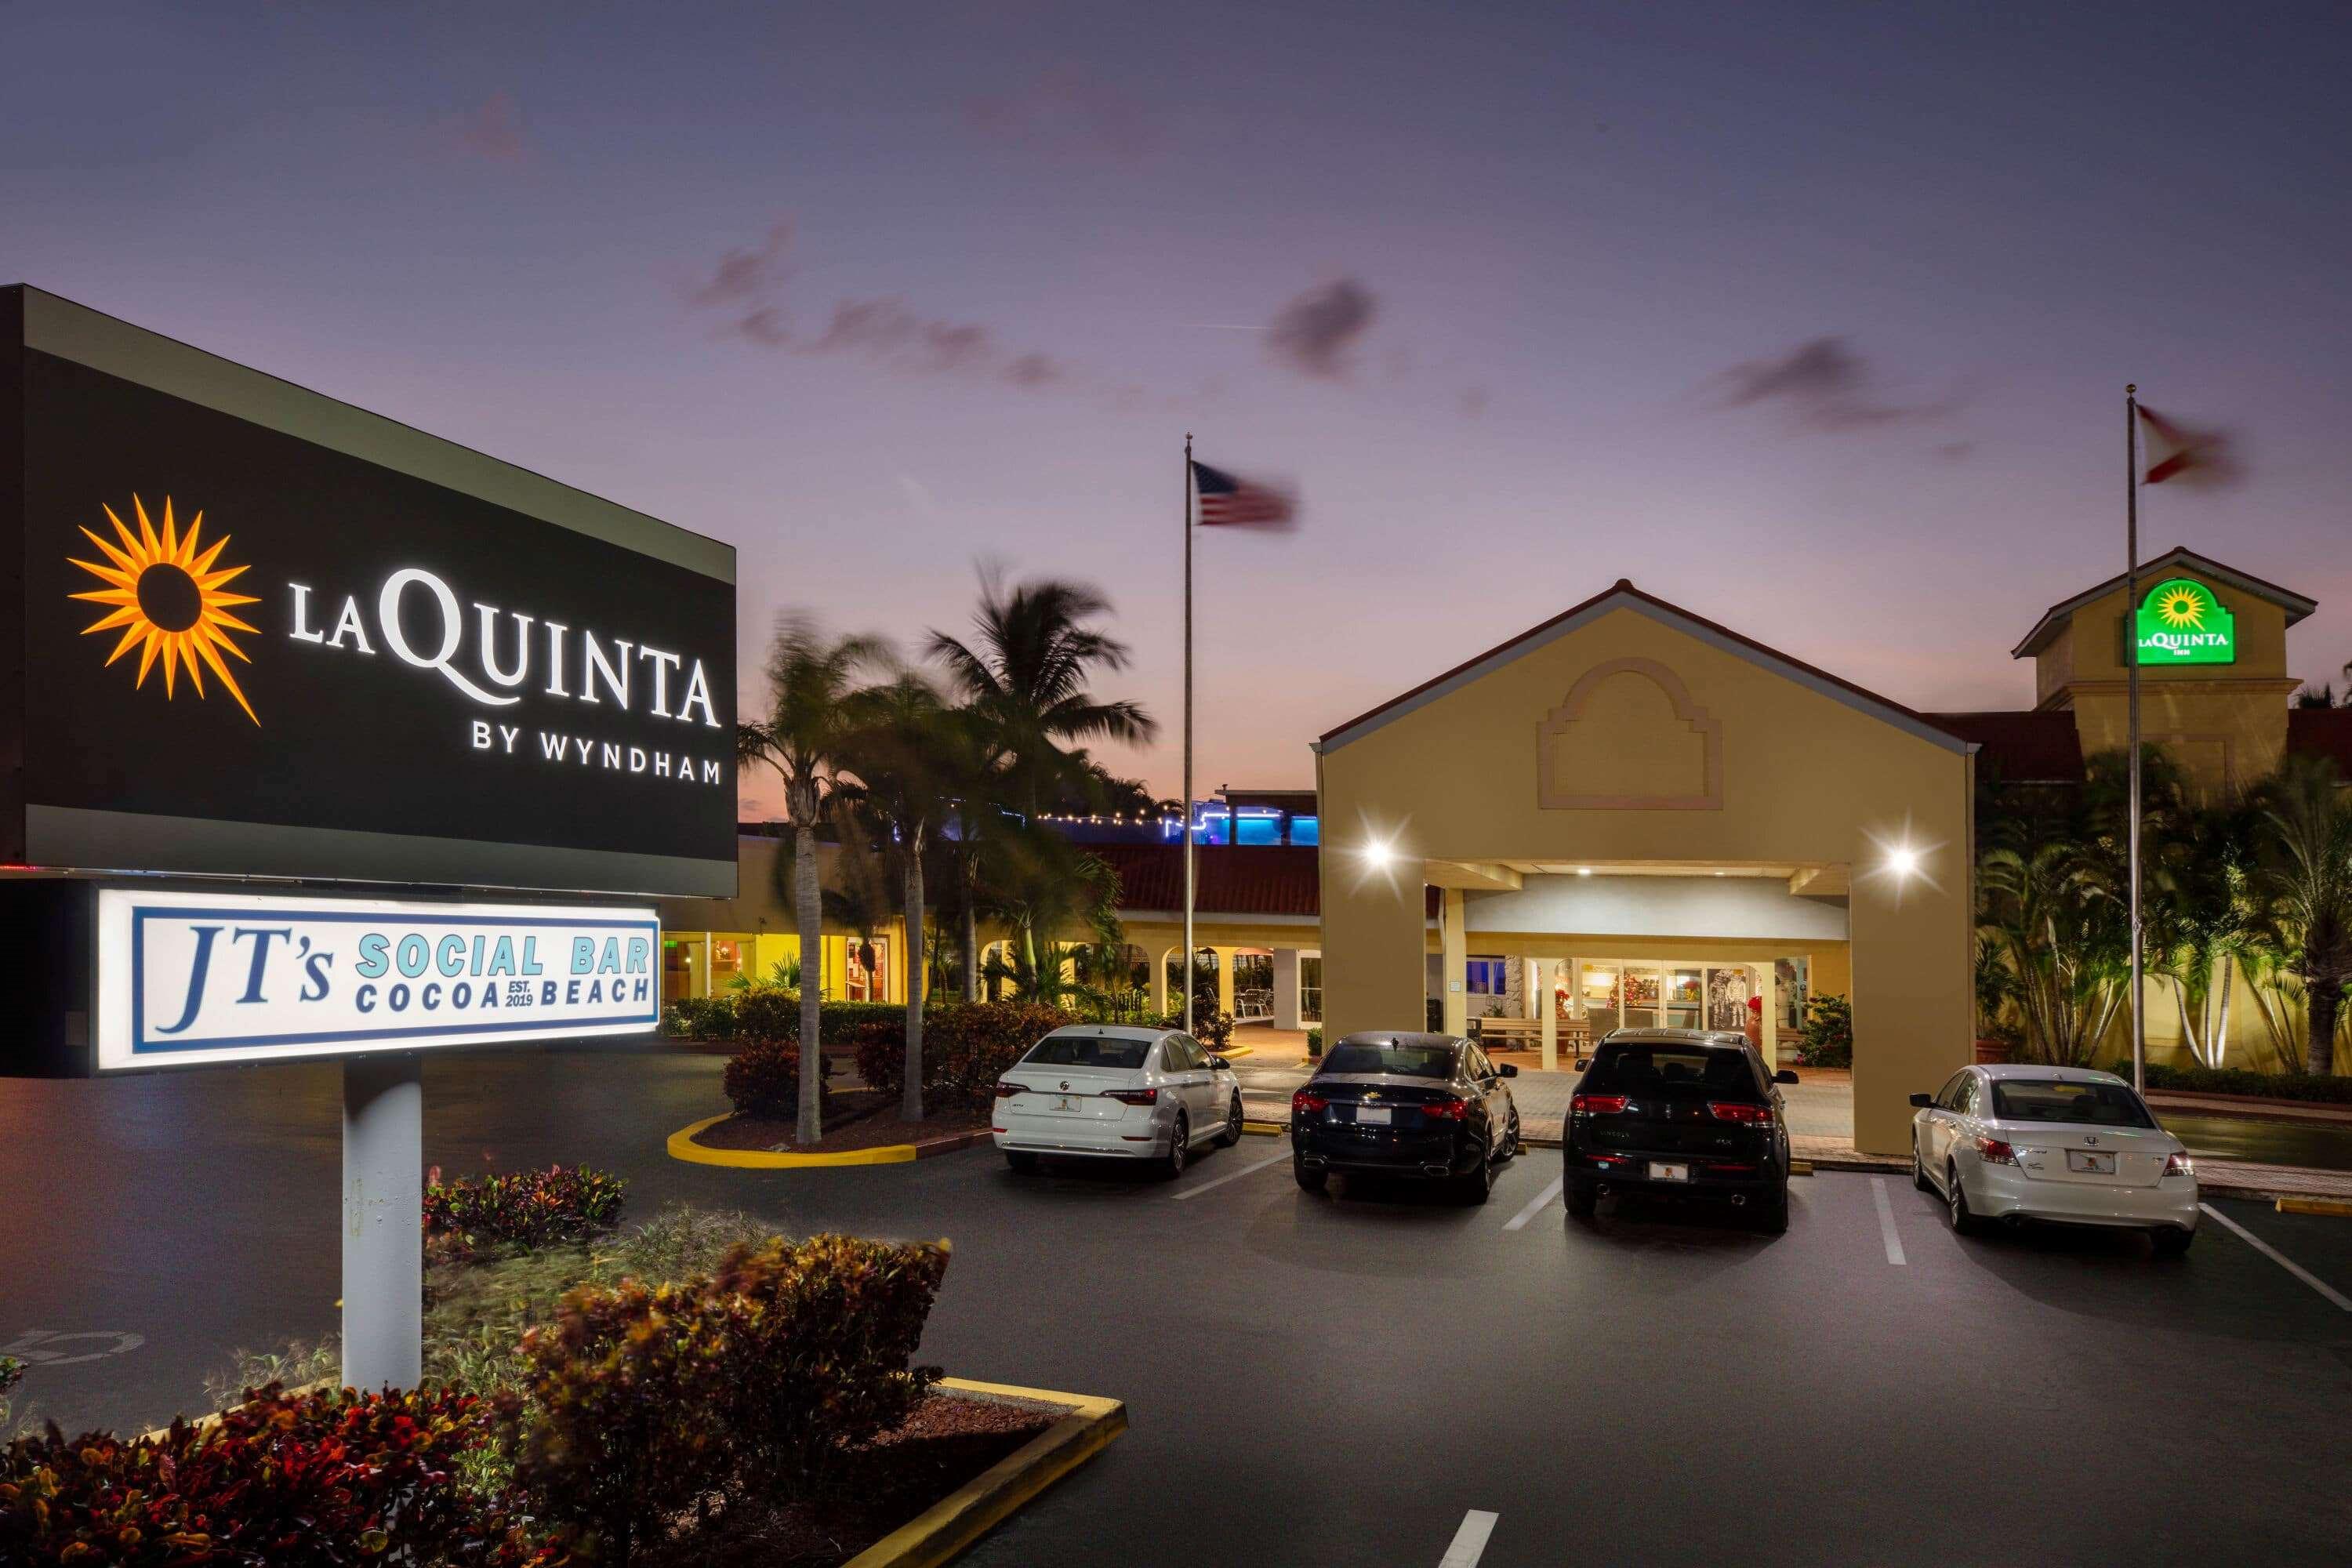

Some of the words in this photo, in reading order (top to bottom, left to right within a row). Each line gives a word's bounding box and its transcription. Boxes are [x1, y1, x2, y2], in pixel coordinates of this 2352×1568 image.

[289, 583, 376, 655] LA
[379, 568, 722, 728] QUINTA
[2151, 633, 2228, 650] QUINTA
[473, 720, 520, 753] BY
[539, 731, 720, 785] WYNDHAM
[355, 932, 544, 979] SOCIAL
[570, 936, 649, 975] BAR
[154, 925, 334, 1035] JT's
[355, 982, 499, 1014] COCOA
[539, 978, 649, 1007] BEACH
[505, 993, 534, 1007] 2019
[508, 980, 531, 993] EST.
